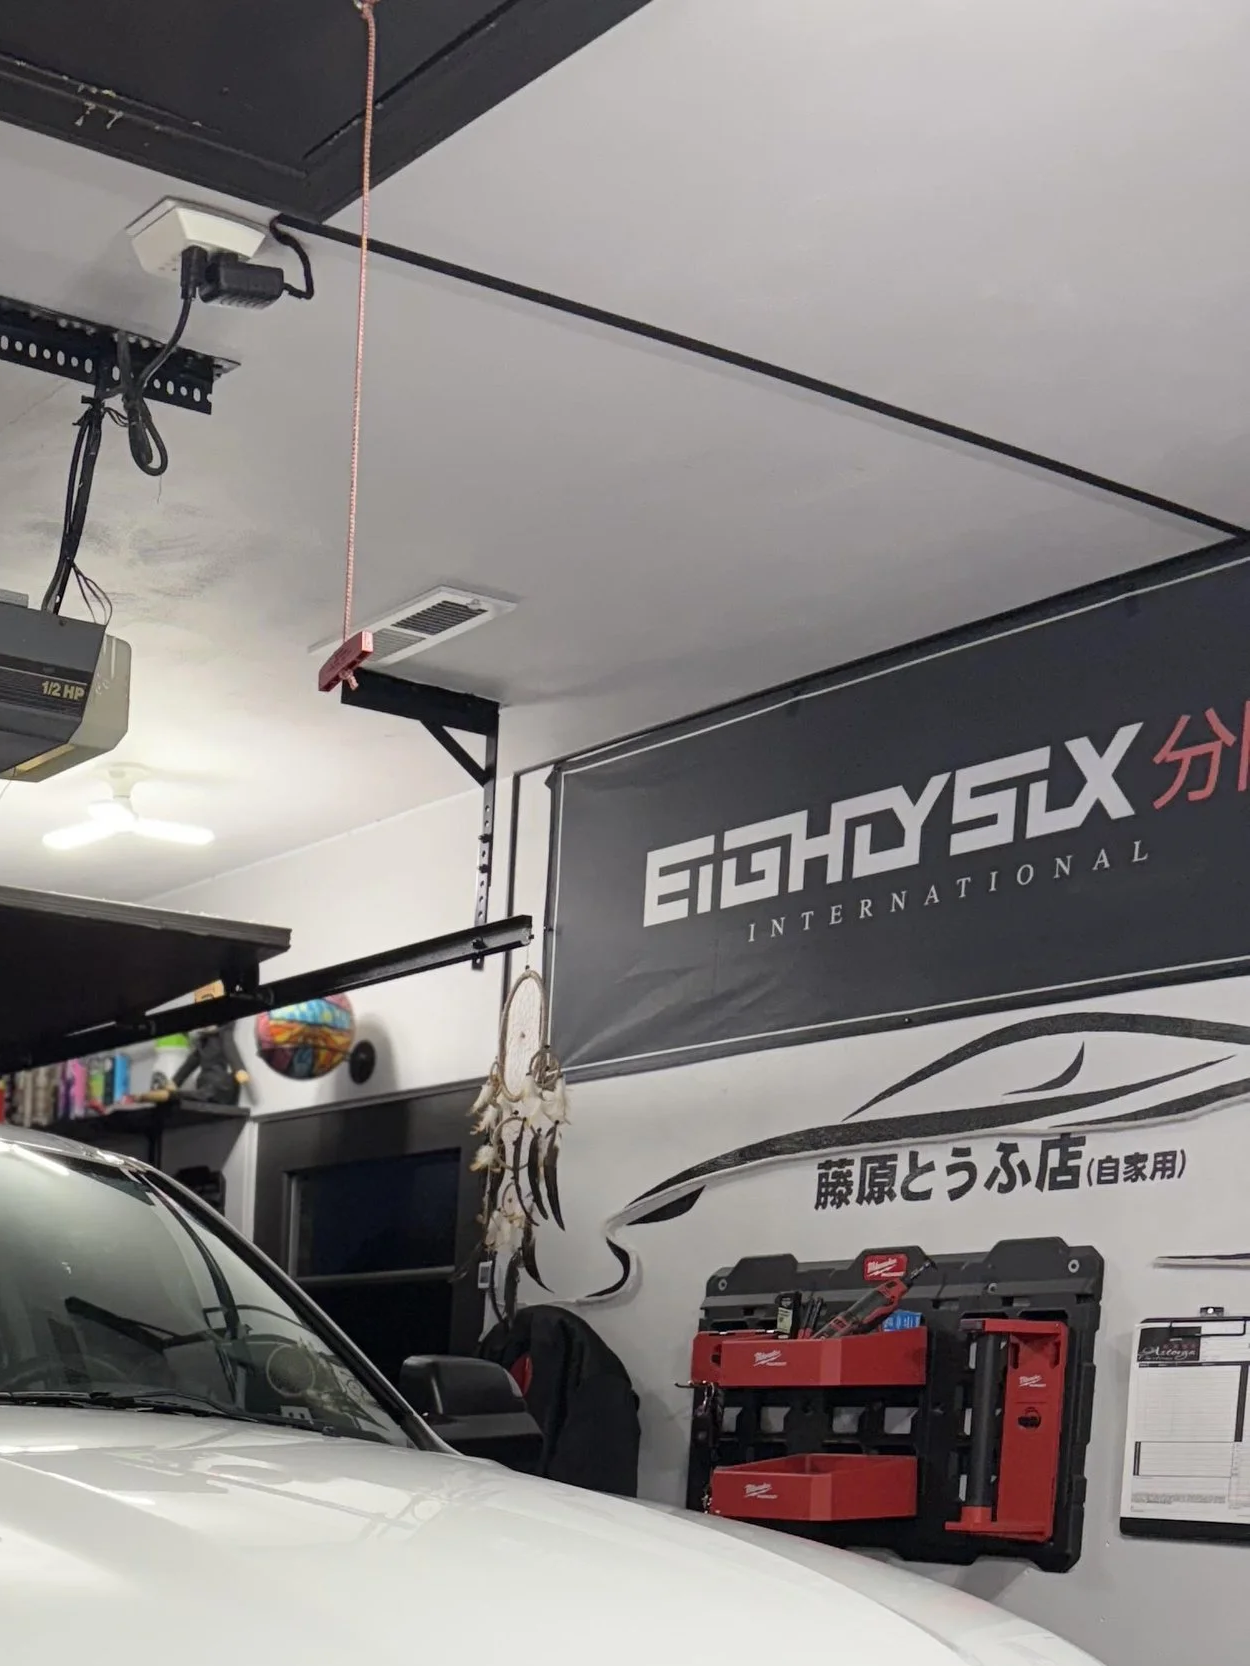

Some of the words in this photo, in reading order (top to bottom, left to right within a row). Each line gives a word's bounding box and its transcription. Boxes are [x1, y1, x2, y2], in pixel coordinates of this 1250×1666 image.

[41, 681, 61, 698] 1/2
[62, 684, 86, 701] HP
[1152, 700, 1250, 810] 分
[748, 839, 1149, 943] INTERNATIONAL
